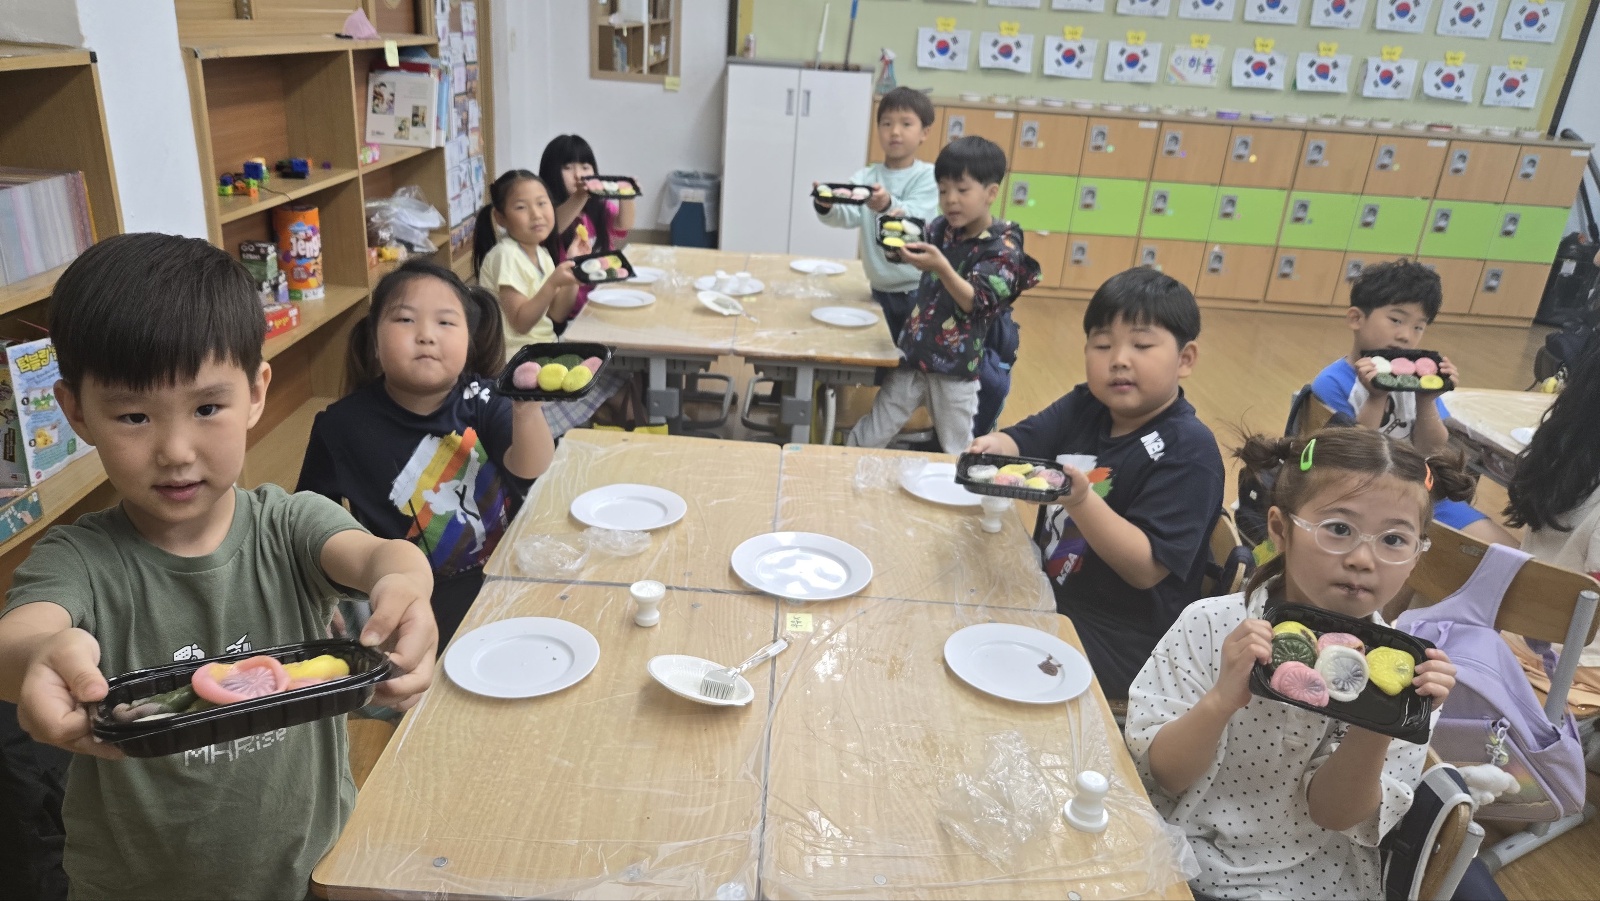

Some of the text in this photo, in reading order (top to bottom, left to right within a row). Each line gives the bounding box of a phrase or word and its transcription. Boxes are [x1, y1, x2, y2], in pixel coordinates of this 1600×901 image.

[290, 236, 321, 258] Jeng
[15, 345, 58, 374] 텀블링
[1055, 552, 1078, 586] NBA
